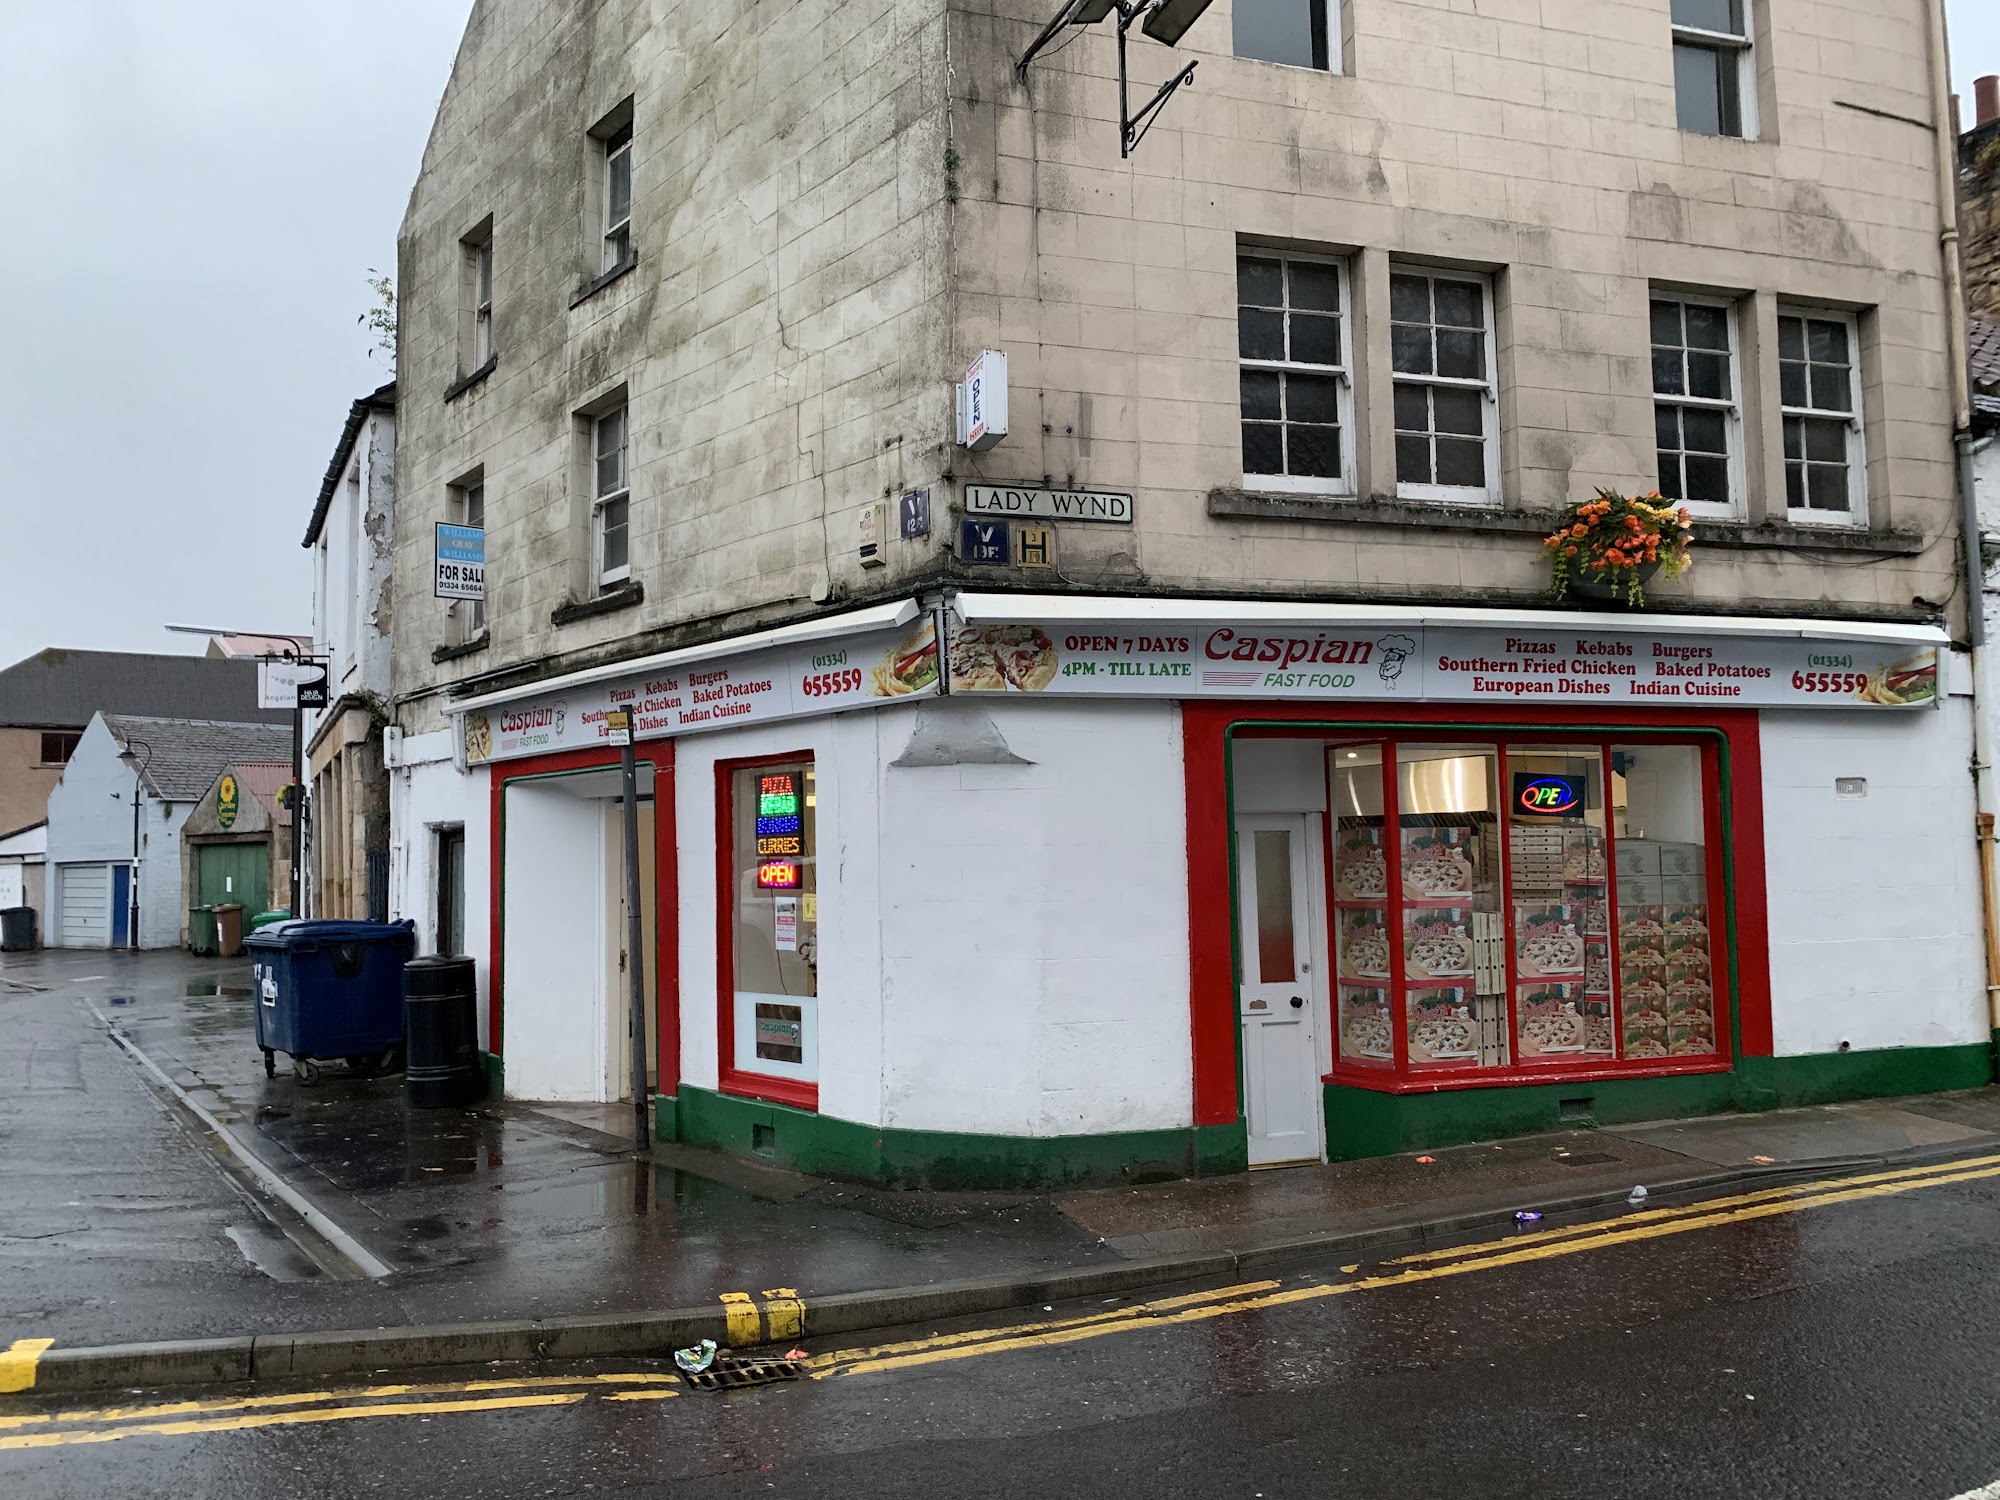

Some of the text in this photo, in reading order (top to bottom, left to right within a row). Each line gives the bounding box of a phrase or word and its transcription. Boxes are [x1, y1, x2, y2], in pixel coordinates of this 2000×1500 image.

[973, 378, 981, 426] OPEN
[974, 490, 1126, 518] LADY WYND
[452, 540, 474, 549] GRAY
[440, 565, 459, 580] FOR
[461, 584, 484, 592] 65664
[1065, 636, 1189, 654] OPEN 7 DAYS
[1205, 628, 1373, 670] Caspian
[1505, 638, 1713, 660] Pizzas Kebabs Burgers
[812, 649, 847, 670] (01334)
[1062, 662, 1096, 676] 4PM
[1108, 663, 1145, 676] TILL
[1149, 663, 1192, 676] LATE
[1438, 656, 1771, 678] Southern Fried Chicken Baked Potatoes
[1808, 654, 1852, 668] (01334)
[610, 670, 729, 703] Pizzas Kebabs Burgers
[803, 668, 862, 697] 655559
[1264, 673, 1355, 688] FAST FOOD
[1473, 677, 1741, 696] European Dishes Indian Cuisine
[1792, 671, 1867, 694] 655559
[645, 697, 682, 713] Chicken
[693, 686, 724, 704] Baked
[726, 680, 772, 698] Potatoes
[501, 706, 552, 735] Caspian
[639, 716, 668, 731] Dishes
[679, 708, 711, 724] Indian
[713, 702, 752, 718] Cuisine
[519, 733, 549, 747] FAST FOOD
[1521, 787, 1570, 805] OPEN
[758, 837, 799, 854] CURRIES
[761, 865, 793, 883] OPEN
